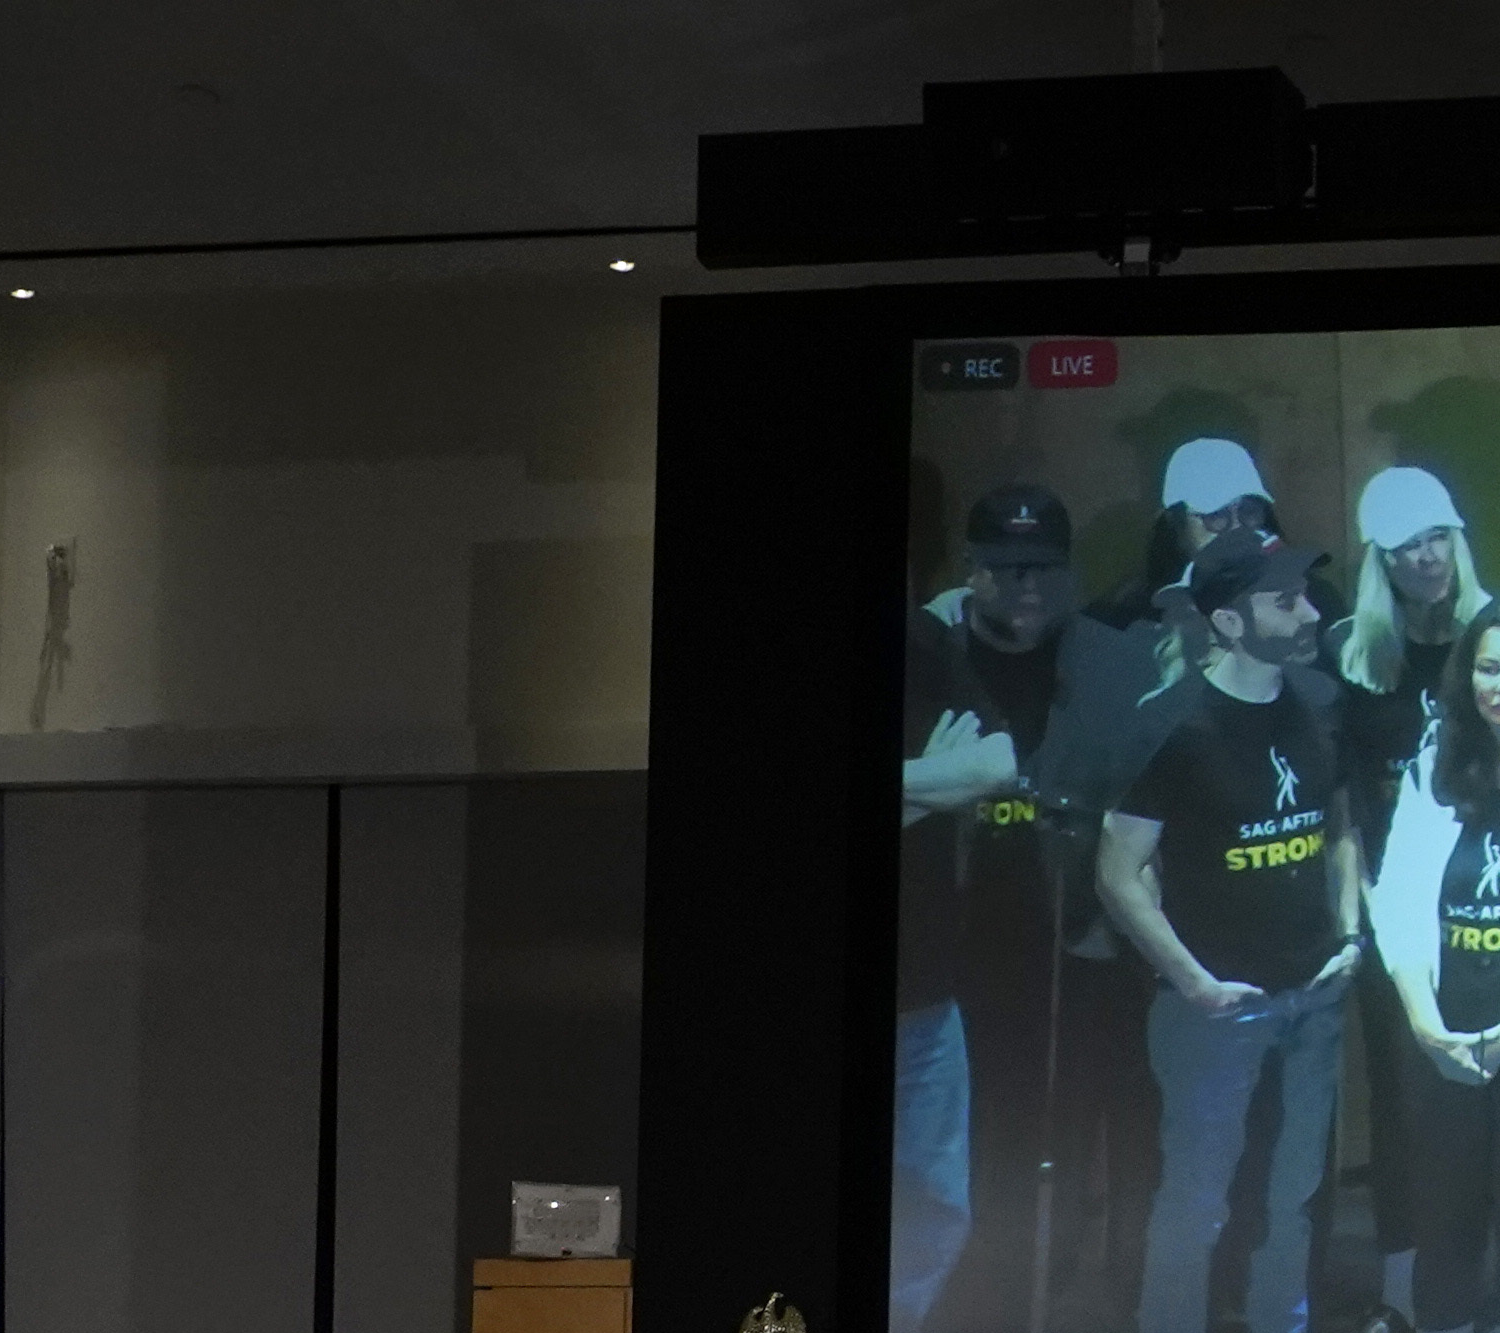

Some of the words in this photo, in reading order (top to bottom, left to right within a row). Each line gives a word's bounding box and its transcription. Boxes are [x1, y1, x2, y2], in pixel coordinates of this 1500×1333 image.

[964, 358, 1003, 378] REC
[1051, 354, 1094, 376] LIVE
[1225, 831, 1325, 872] STRON
